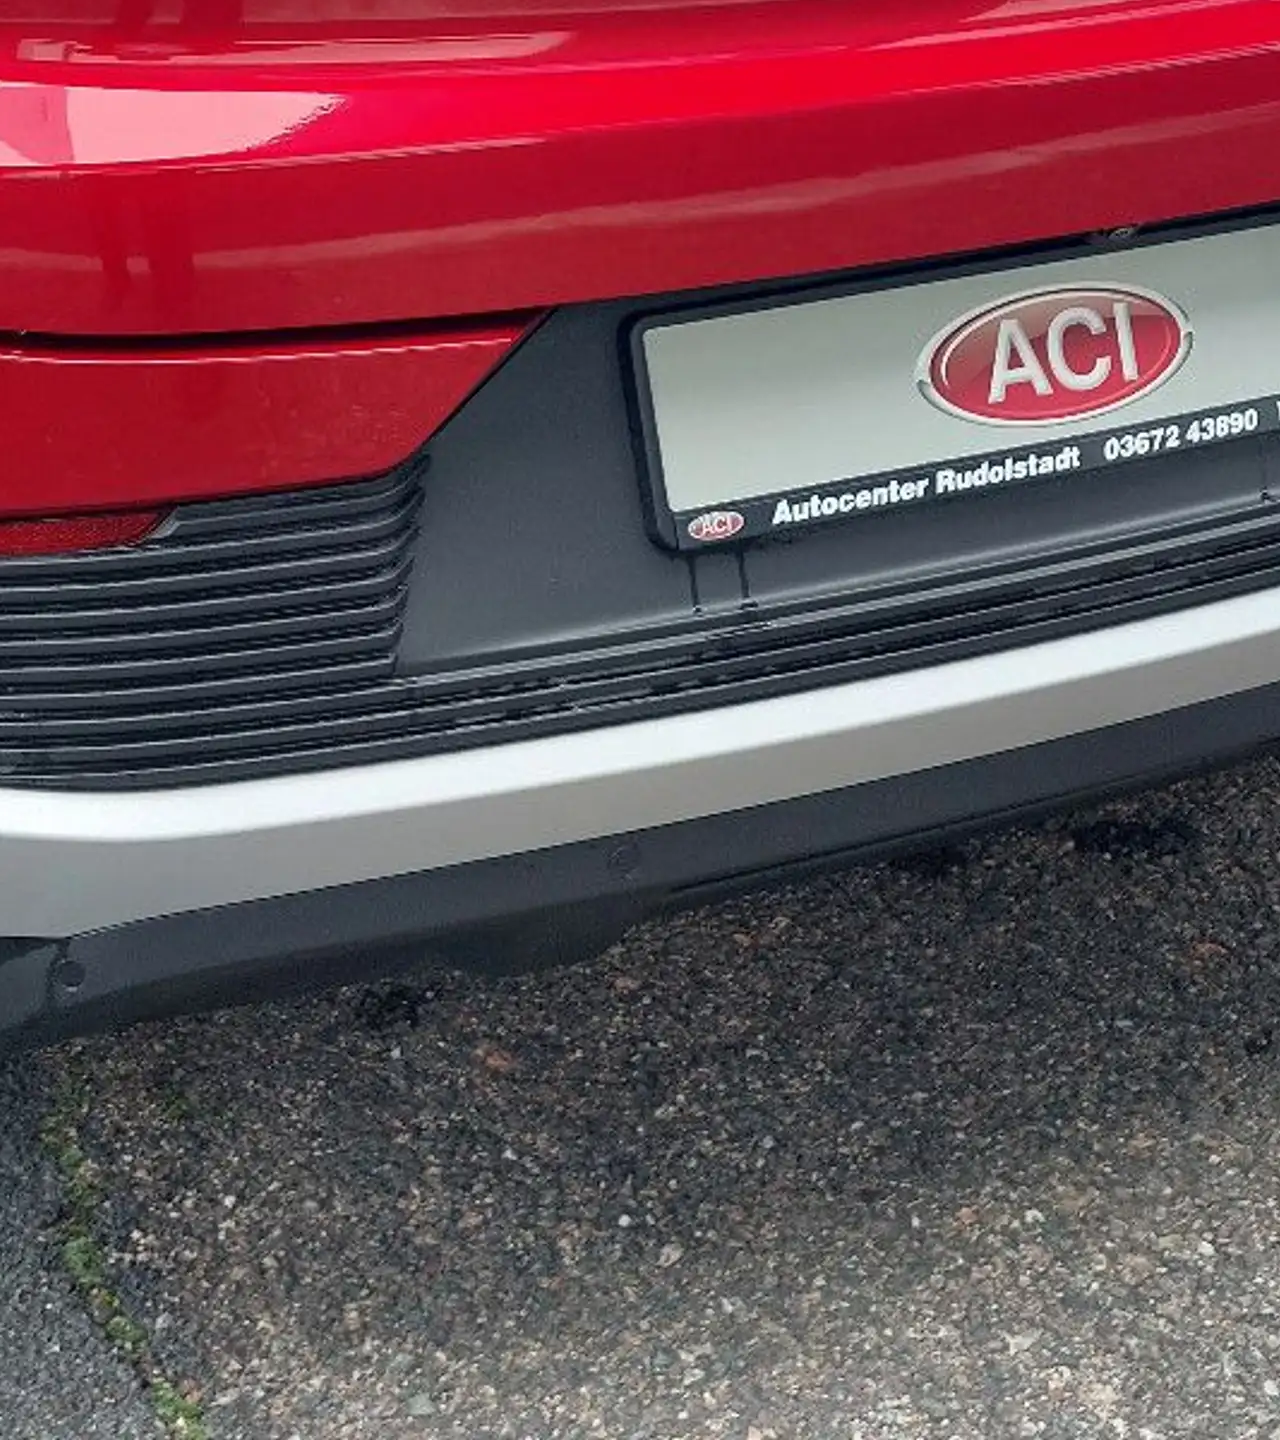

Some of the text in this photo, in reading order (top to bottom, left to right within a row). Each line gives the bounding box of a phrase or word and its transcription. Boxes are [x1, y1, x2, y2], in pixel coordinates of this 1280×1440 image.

[987, 301, 1139, 405] ACI
[771, 478, 930, 527] Autocenter
[935, 445, 1081, 495] Rudolstadt
[1103, 424, 1181, 461] 03672
[1185, 408, 1259, 444] 43890
